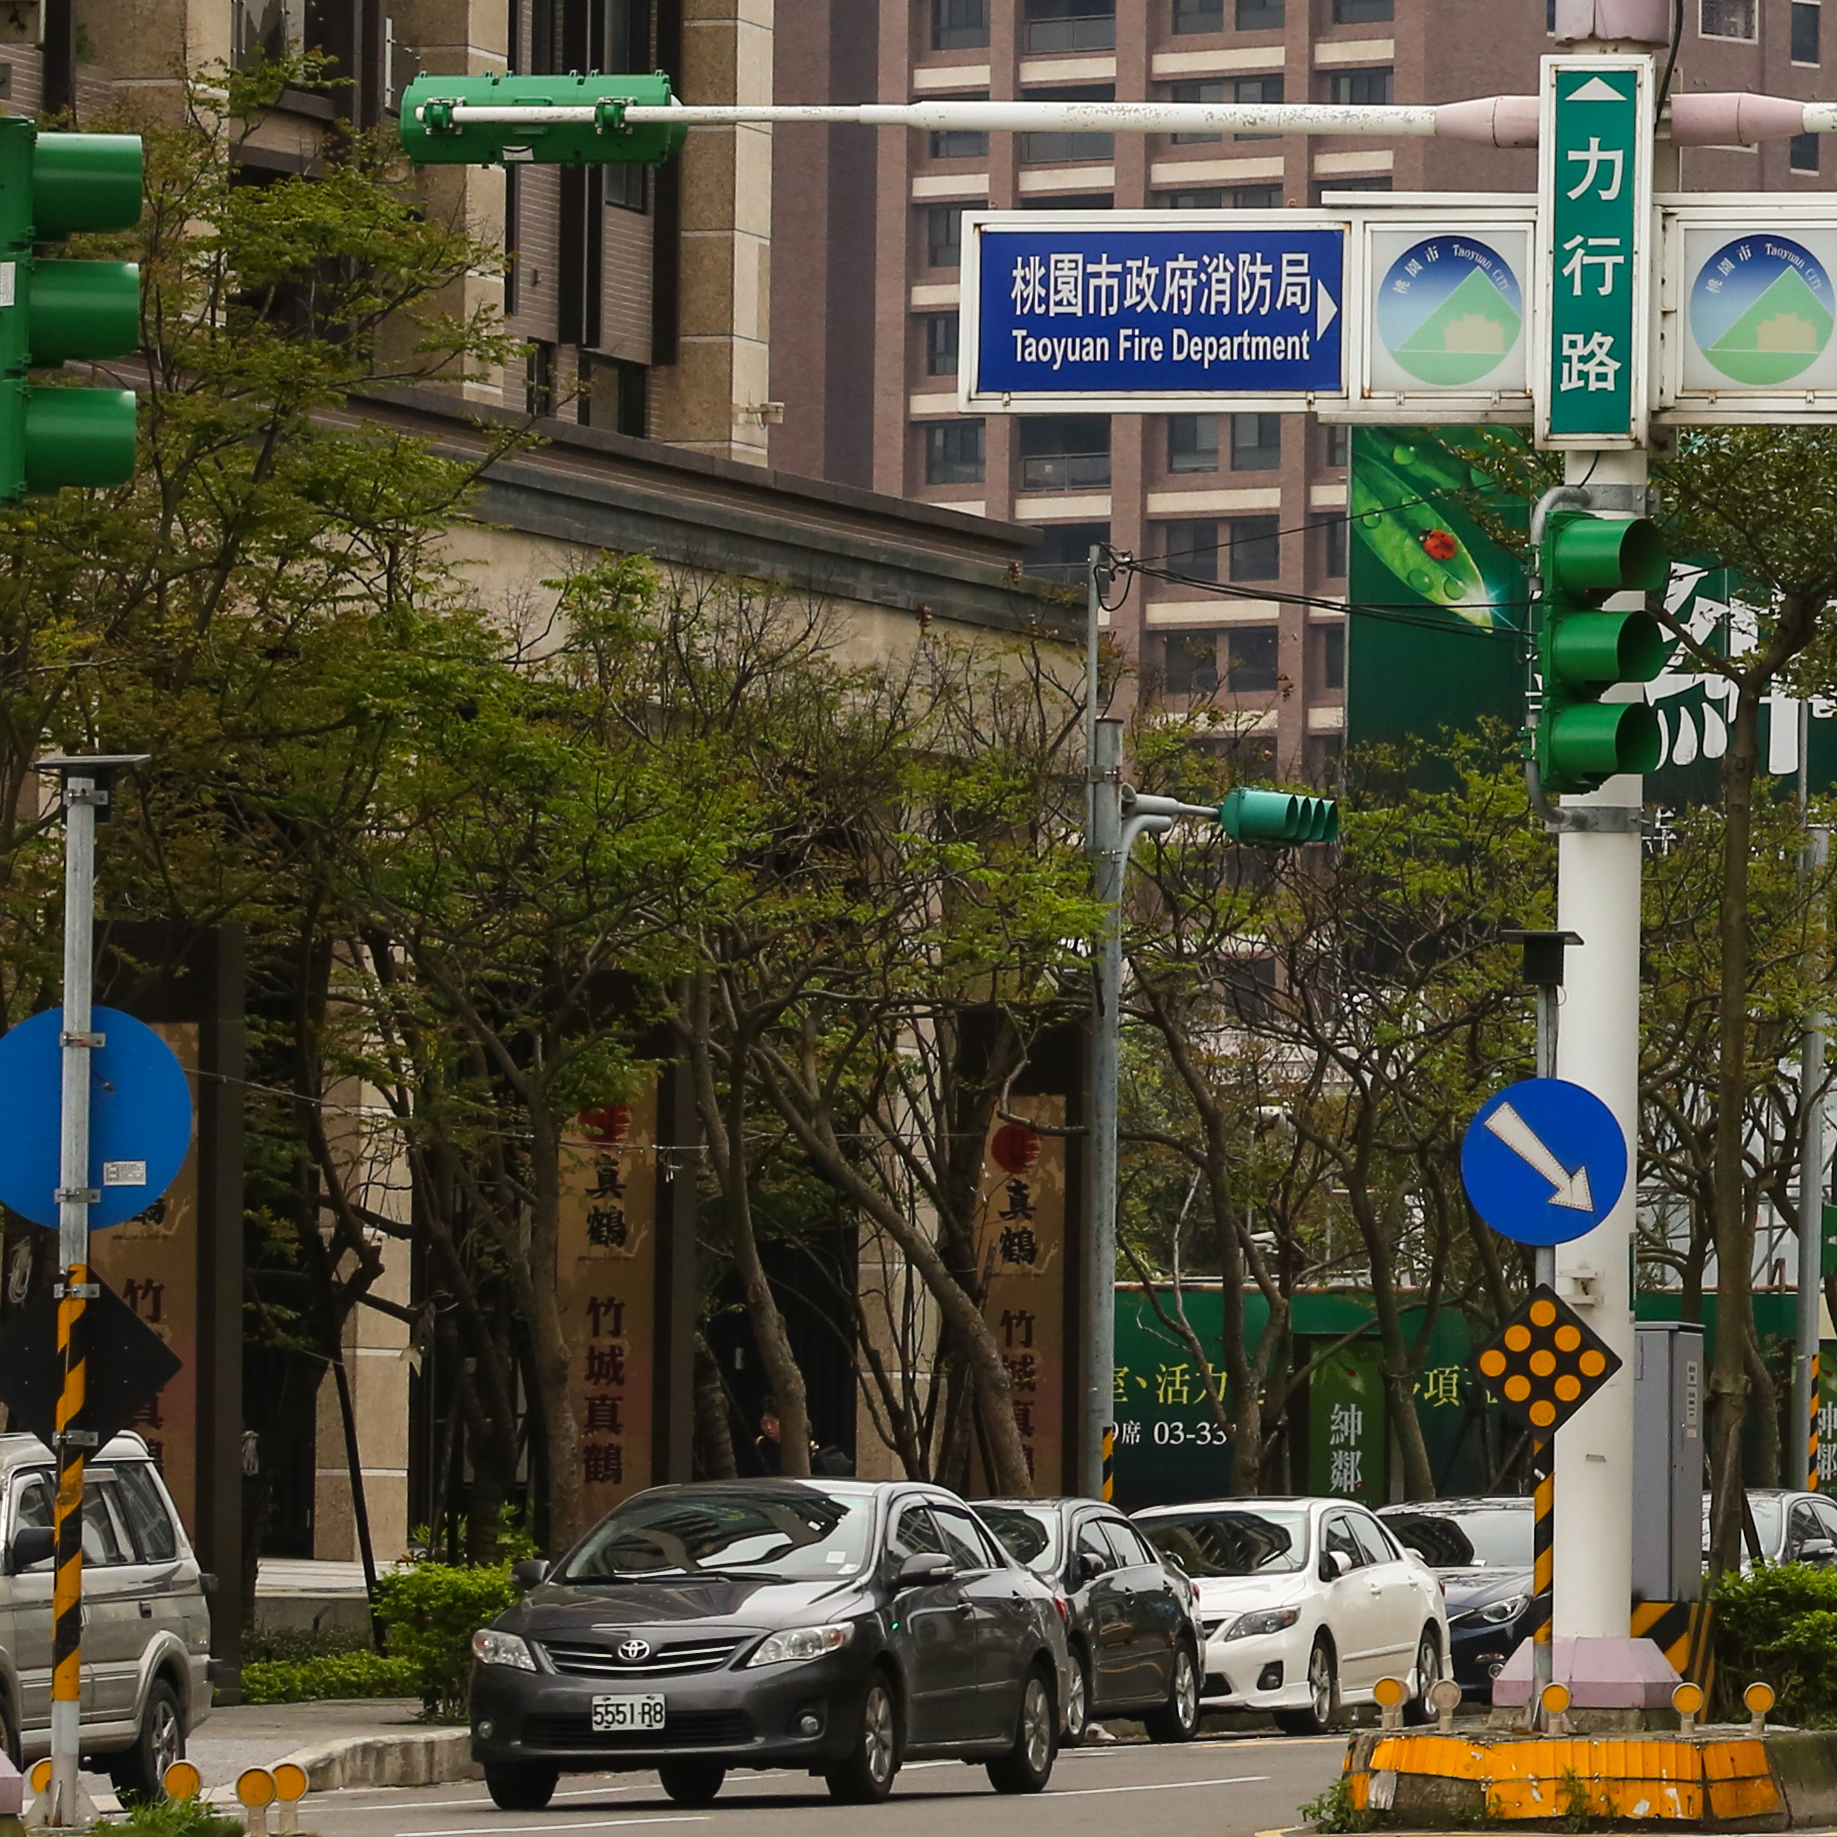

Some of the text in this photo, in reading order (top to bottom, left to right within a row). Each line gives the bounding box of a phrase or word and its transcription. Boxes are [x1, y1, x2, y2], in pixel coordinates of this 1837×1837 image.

[1010, 253, 1311, 317] 桃園市政府消防局
[1560, 136, 1625, 392] 力行路
[1012, 328, 1310, 370] Taoyuan Fire Department
[593, 1702, 663, 1725] 5551-R8
